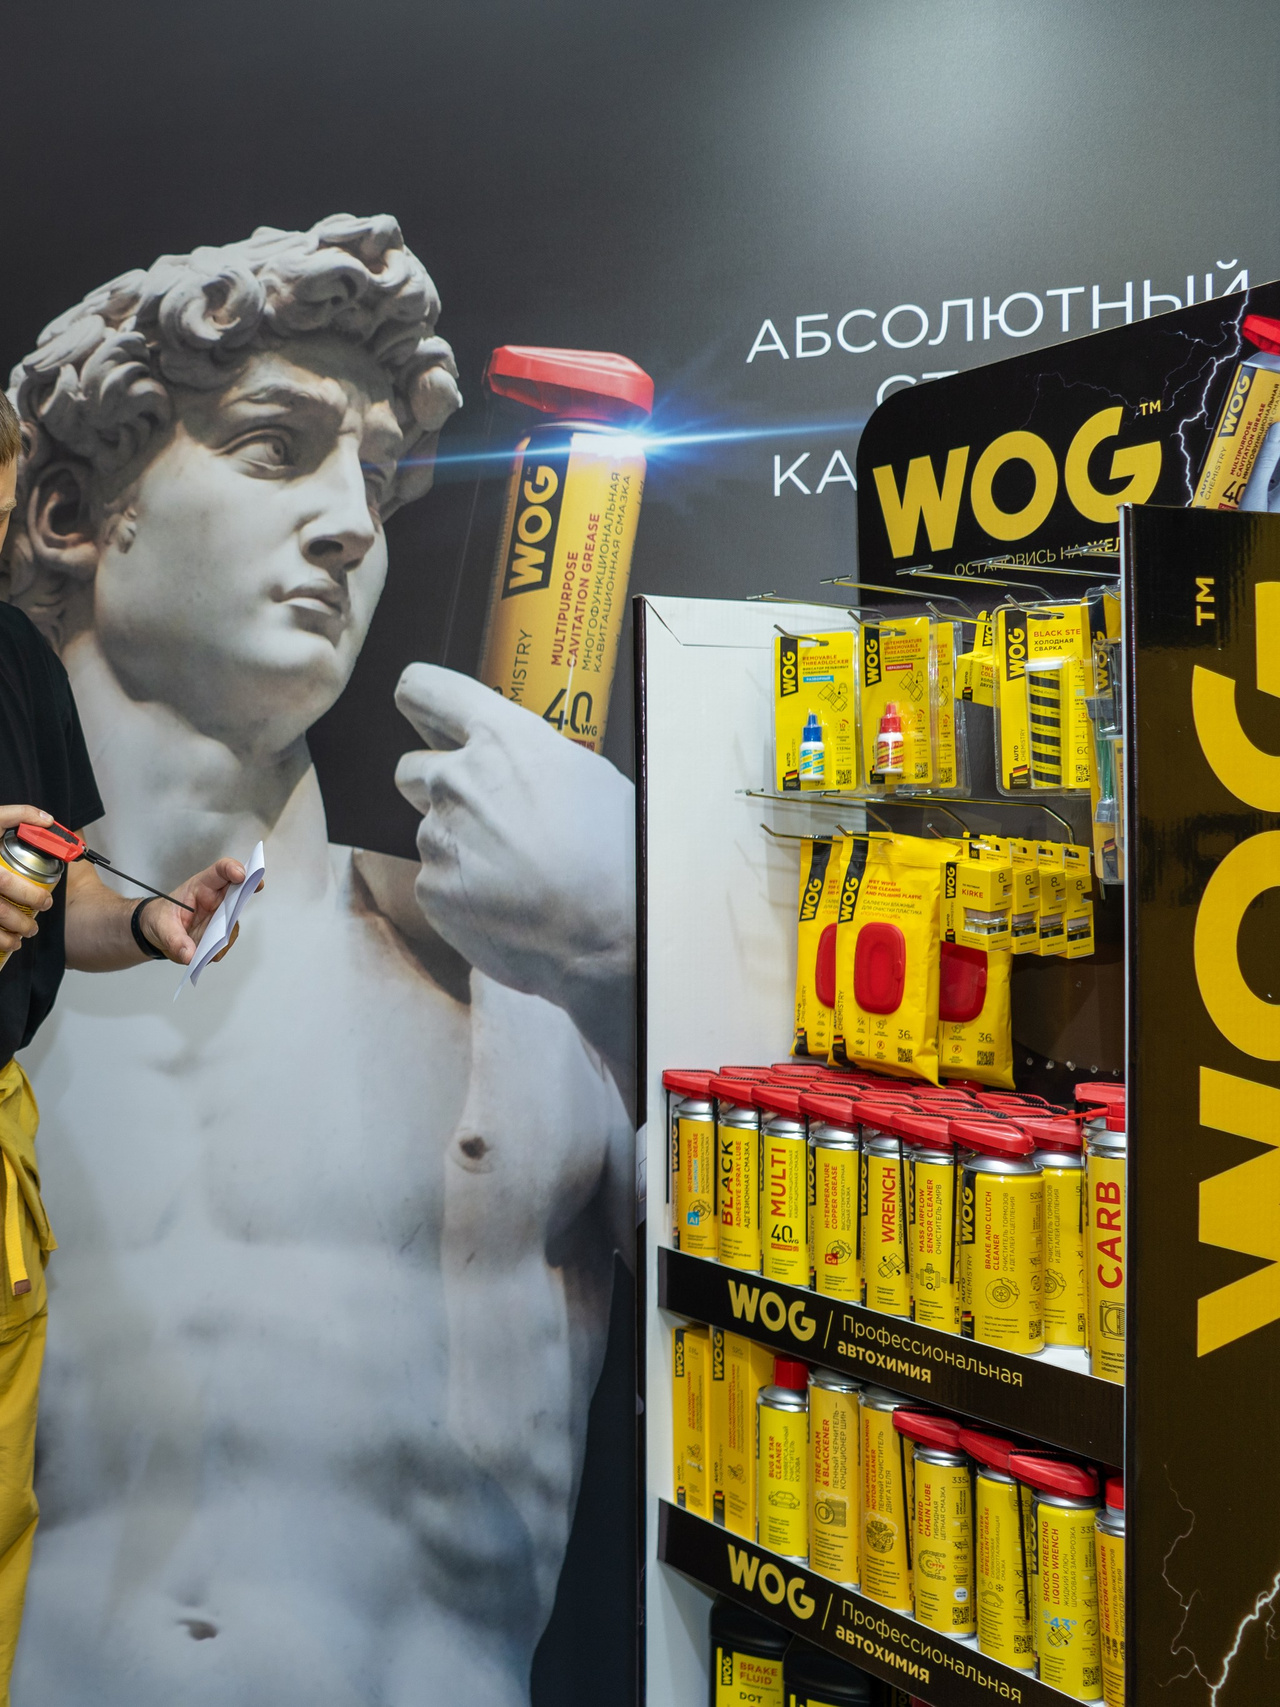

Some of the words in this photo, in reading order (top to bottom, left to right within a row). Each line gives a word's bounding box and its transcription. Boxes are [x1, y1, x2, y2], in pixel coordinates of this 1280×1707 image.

[745, 258, 1250, 363] АБСОЛЮТНЫЙ
[1221, 375, 1251, 434] WOG
[1230, 421, 1254, 476] MULTIPURPOSE
[1236, 435, 1256, 478] CAVITATION
[1252, 403, 1267, 434] GREASE
[872, 406, 1163, 560] WOG
[1200, 470, 1211, 498] AUTO
[1205, 446, 1227, 500] CHEMISTRY
[508, 465, 559, 589] WOG
[566, 577, 590, 668] CAVITATION
[581, 513, 600, 573] GREASE
[582, 472, 620, 671] МНОГОФУНКЦИОНАЛЬНАЯ
[594, 538, 621, 673] КАВИТАЦИОННАЯ
[614, 475, 631, 536] СМАЗКА
[551, 551, 579, 666] MULTIPURPOSE
[1034, 630, 1063, 638] BLACK
[866, 639, 880, 684] WOG
[884, 648, 921, 656] THREADLOCKER
[1009, 627, 1026, 678] WOG
[1034, 637, 1074, 645] ХОЛОДНАЯ
[509, 629, 532, 706] MISTRY
[782, 651, 796, 694] WOG
[802, 878, 822, 921] WOG
[840, 877, 859, 921] WOG
[947, 866, 956, 897] WOG
[962, 889, 984, 898] KIRKE
[721, 1140, 733, 1226] BLACK
[771, 1148, 786, 1217] MULTI
[882, 1167, 896, 1243] WRENCH
[771, 1224, 792, 1243] 40
[961, 1186, 973, 1242] WOG
[1096, 1181, 1123, 1289] CARB
[727, 1279, 816, 1342] WOG
[676, 1341, 684, 1376] WOG
[713, 1332, 724, 1380] WOG
[837, 1339, 931, 1383] автохимия
[842, 1314, 1023, 1387] Профессиональная
[727, 1543, 815, 1619] WOG
[1052, 1573, 1060, 1605] LIQUID
[1100, 1545, 1108, 1587] CLEANER
[1103, 1589, 1111, 1633] INJECTOR
[722, 1656, 732, 1684] WOG
[740, 1661, 778, 1677] BRAKE
[836, 1625, 930, 1684] автохимия
[842, 1599, 1022, 1704] Профессиональная
[739, 1692, 763, 1704] DOT
[740, 1671, 772, 1686] FLUID
